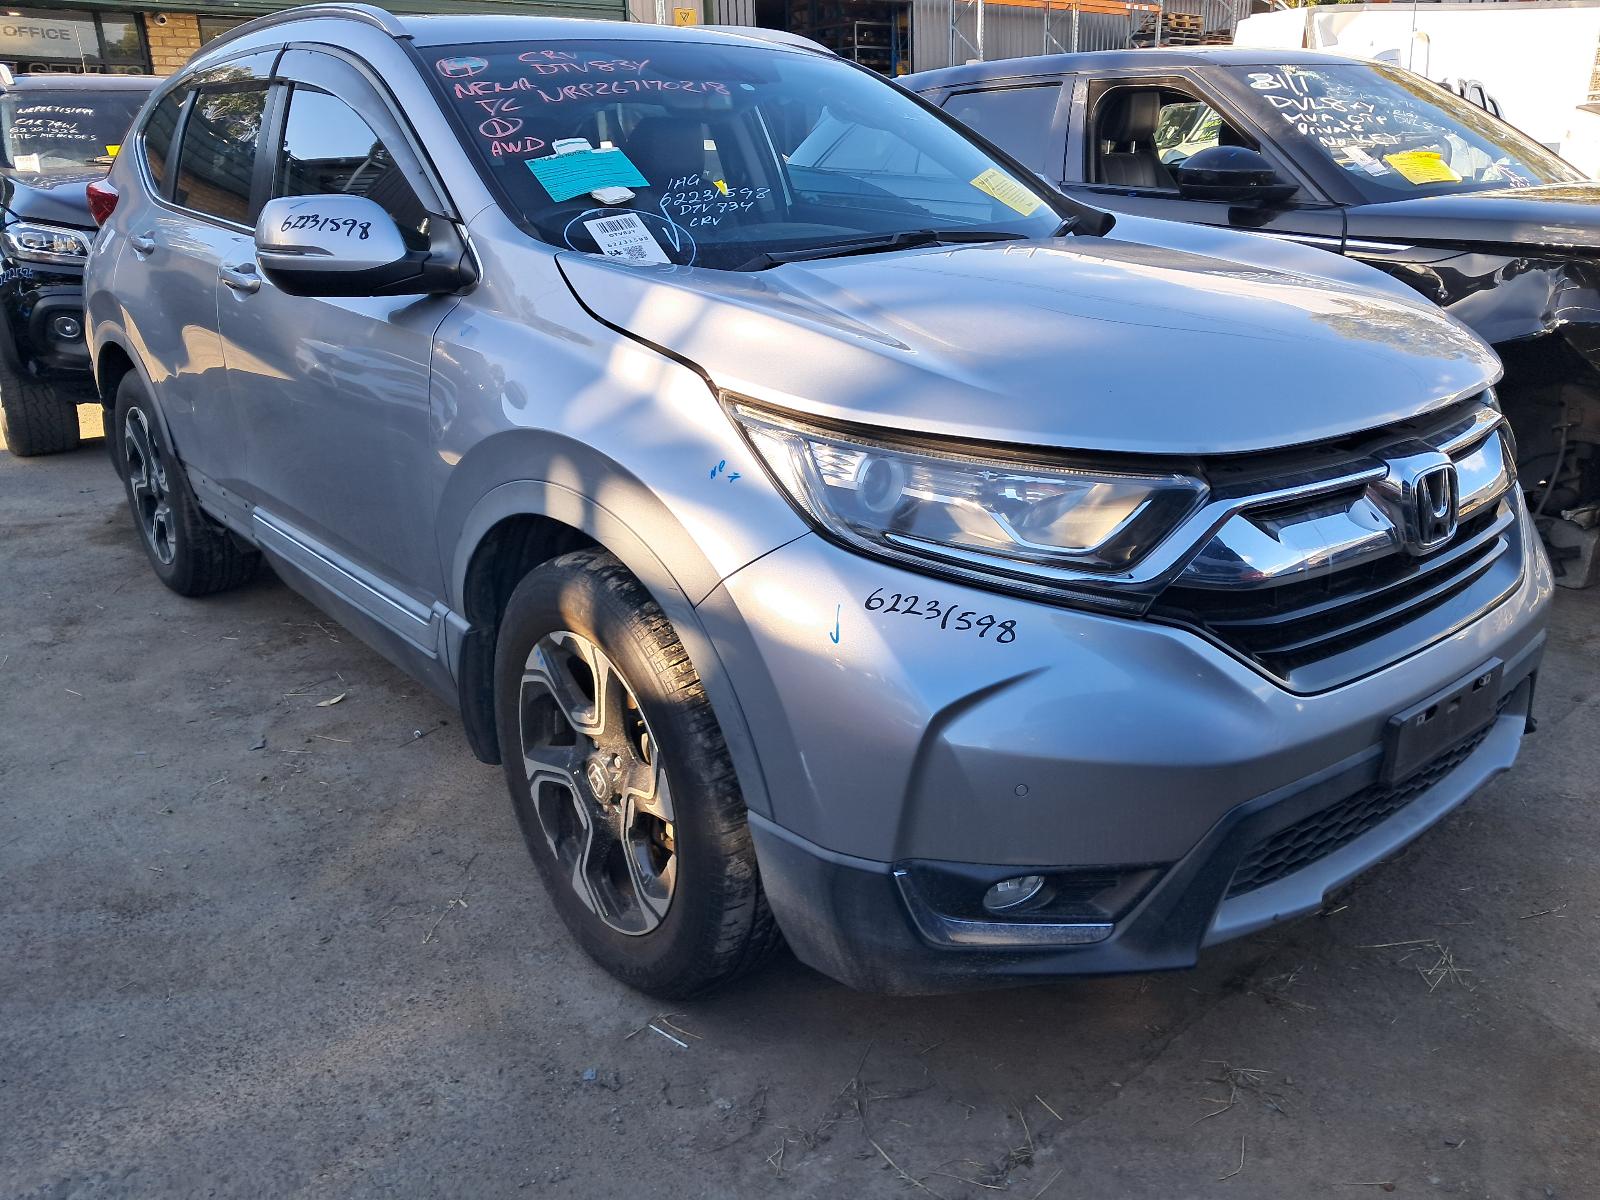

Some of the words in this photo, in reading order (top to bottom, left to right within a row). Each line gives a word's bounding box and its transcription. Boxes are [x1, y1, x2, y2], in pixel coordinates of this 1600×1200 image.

[3, 25, 71, 40] OFFICE
[491, 137, 545, 157] AWD
[689, 215, 722, 227] CRV
[864, 587, 1017, 644] 62231598
